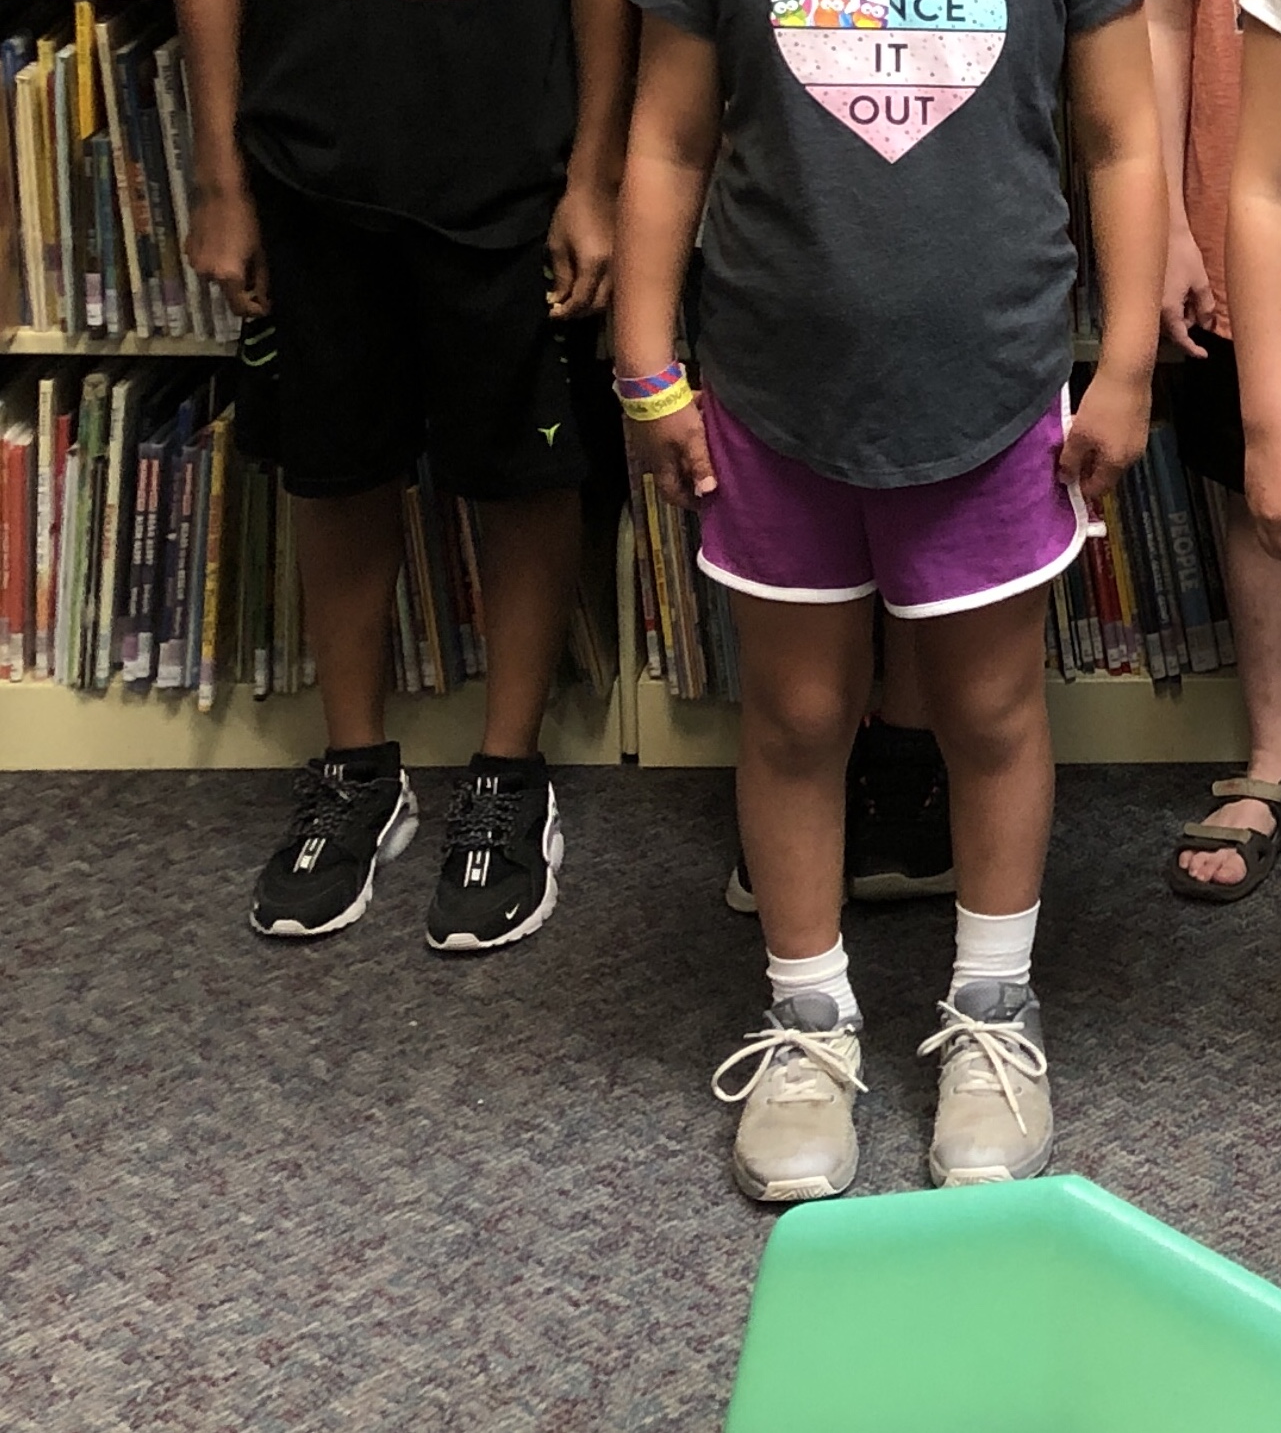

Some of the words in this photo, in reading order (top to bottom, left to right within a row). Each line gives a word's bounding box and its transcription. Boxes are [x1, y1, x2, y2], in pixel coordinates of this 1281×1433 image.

[874, 43, 908, 73] IT
[848, 95, 935, 126] OUT
[1167, 511, 1202, 594] PEOPLE
